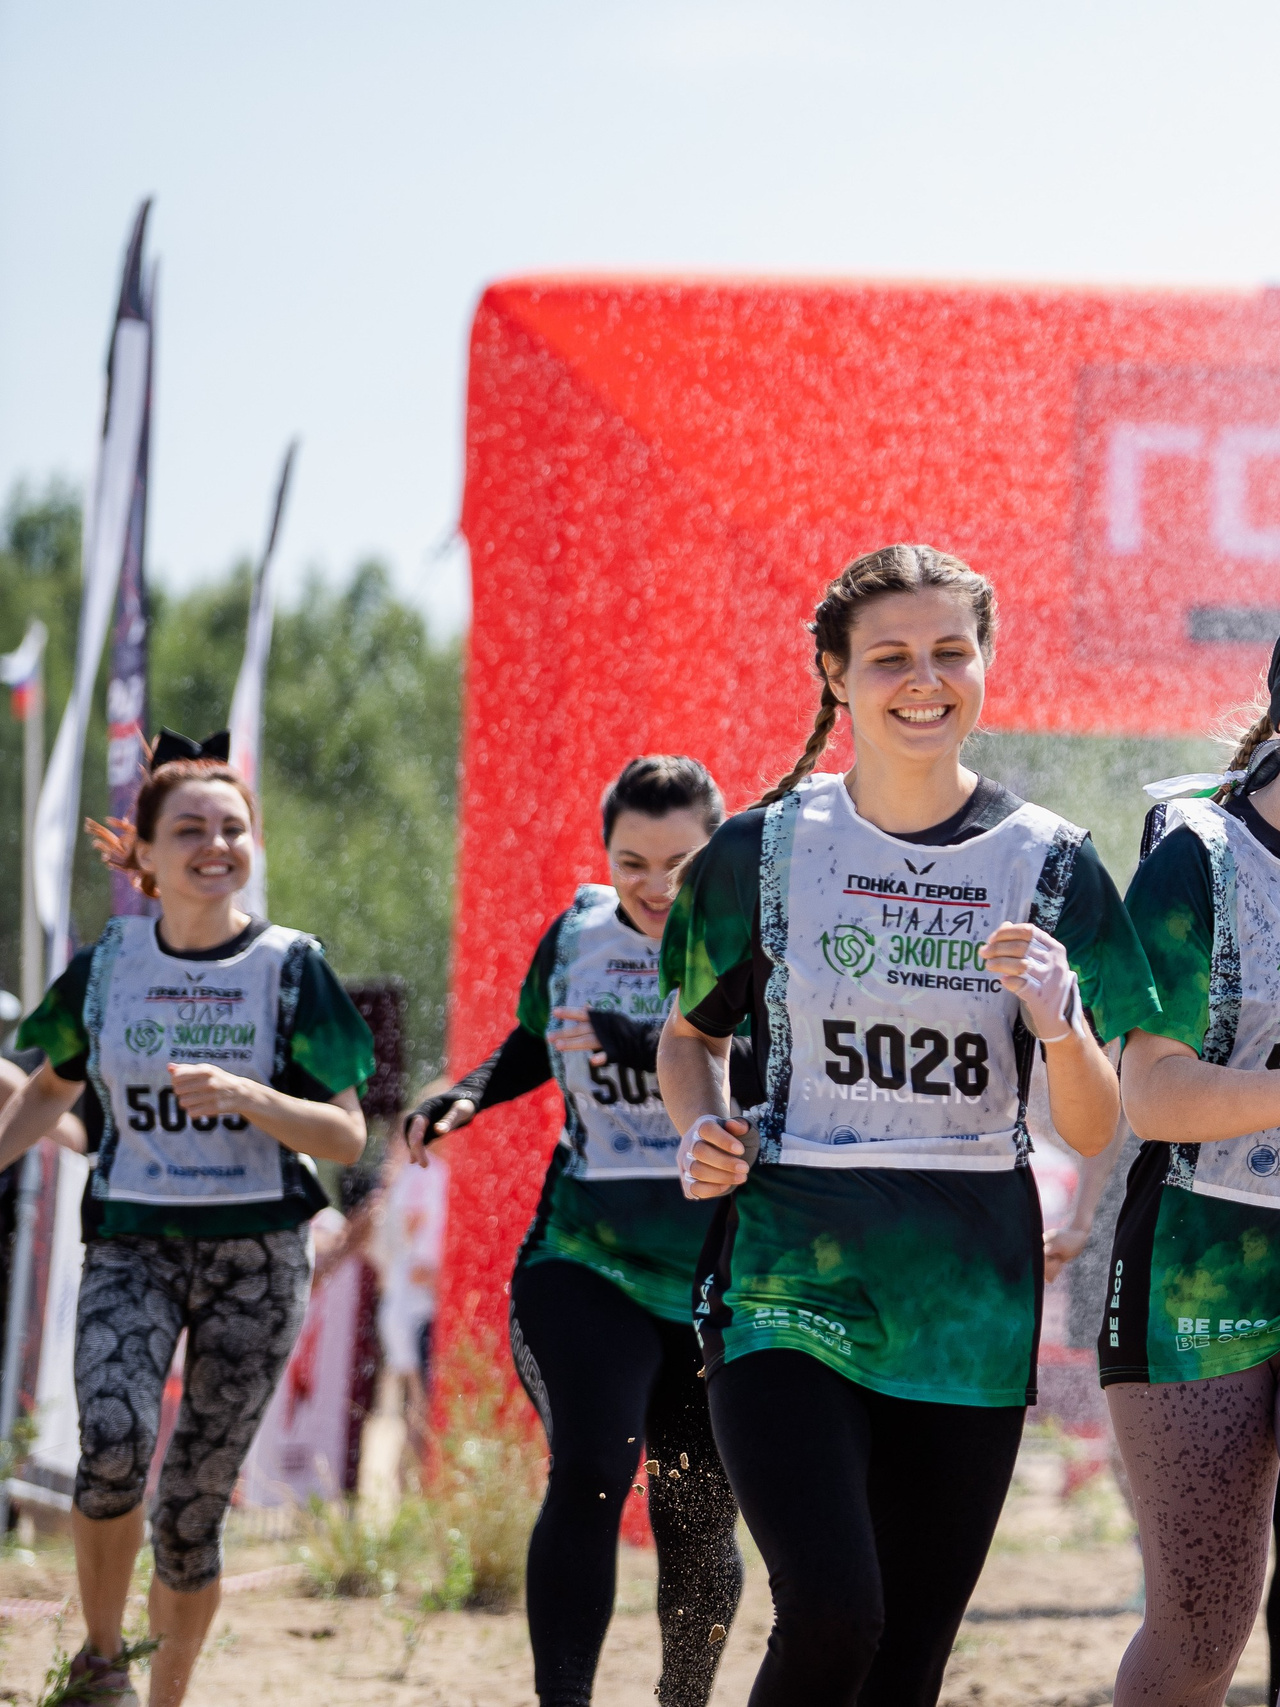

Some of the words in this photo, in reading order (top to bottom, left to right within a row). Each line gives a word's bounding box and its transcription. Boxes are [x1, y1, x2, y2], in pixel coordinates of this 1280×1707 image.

[847, 874, 908, 896] ГОНКА
[914, 883, 987, 901] ГЕРОЕВ
[882, 904, 974, 935] НАДЯ
[889, 935, 988, 971] ЭКОГЕРО
[887, 970, 1002, 993] SYNERGETIC
[172, 1021, 256, 1046] ЭКОГЕРОЙ
[822, 1018, 990, 1097] 5028
[1110, 1259, 1123, 1309] ECO
[754, 1308, 789, 1318] BE
[797, 1309, 846, 1336] ECO
[1109, 1316, 1119, 1347] BE
[1178, 1317, 1210, 1334] BE
[1219, 1319, 1268, 1333] ECO
[1175, 1334, 1210, 1351] BE
